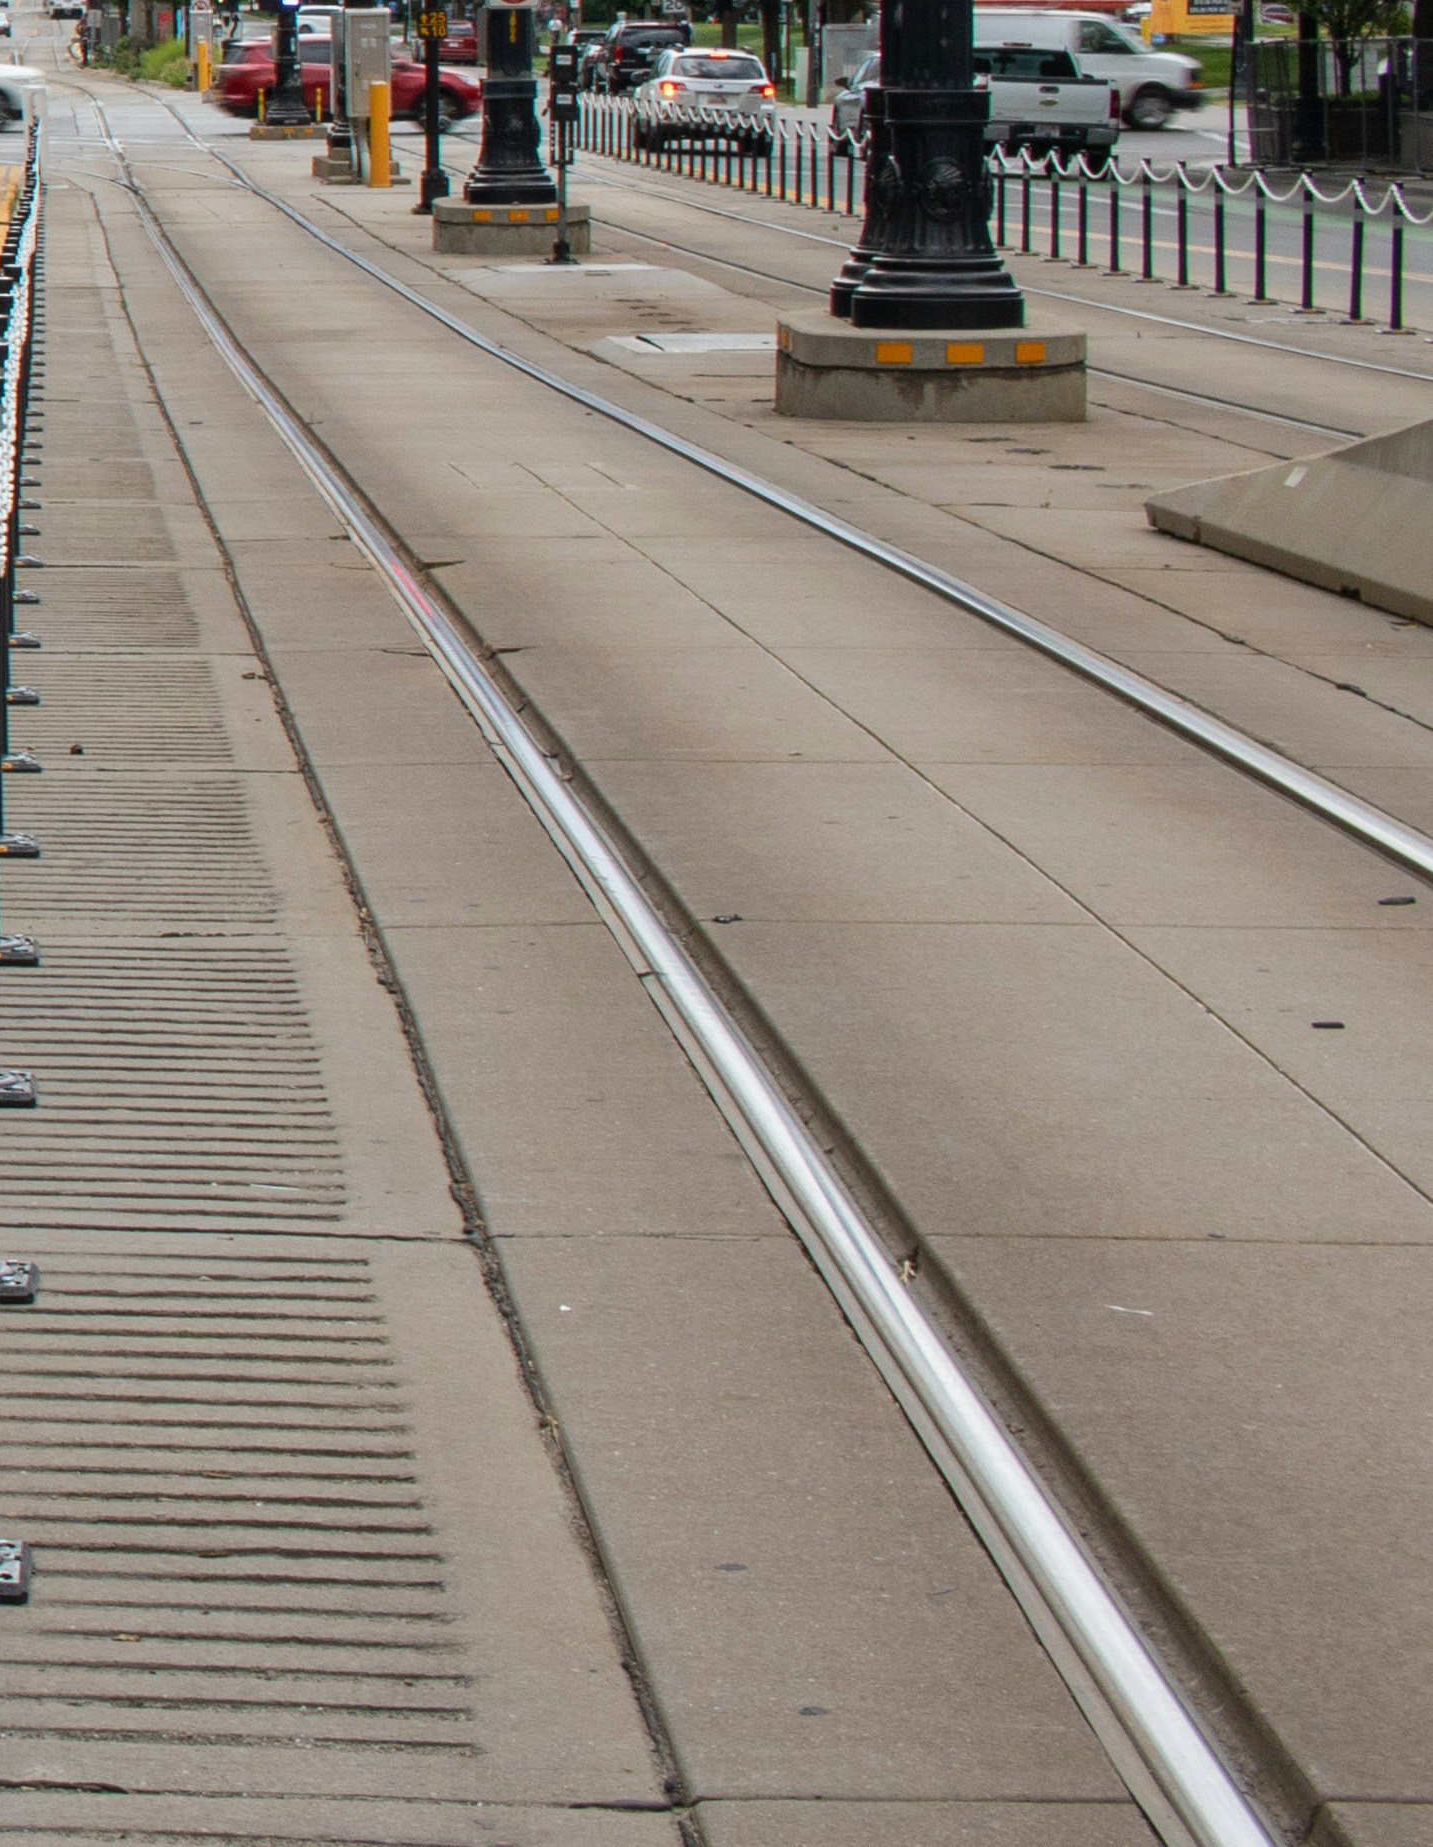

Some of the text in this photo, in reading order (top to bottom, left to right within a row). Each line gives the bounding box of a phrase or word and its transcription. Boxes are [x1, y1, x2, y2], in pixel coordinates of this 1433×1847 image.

[666, 0, 683, 10] 20
[430, 11, 445, 23] 25
[433, 25, 445, 36] 10
